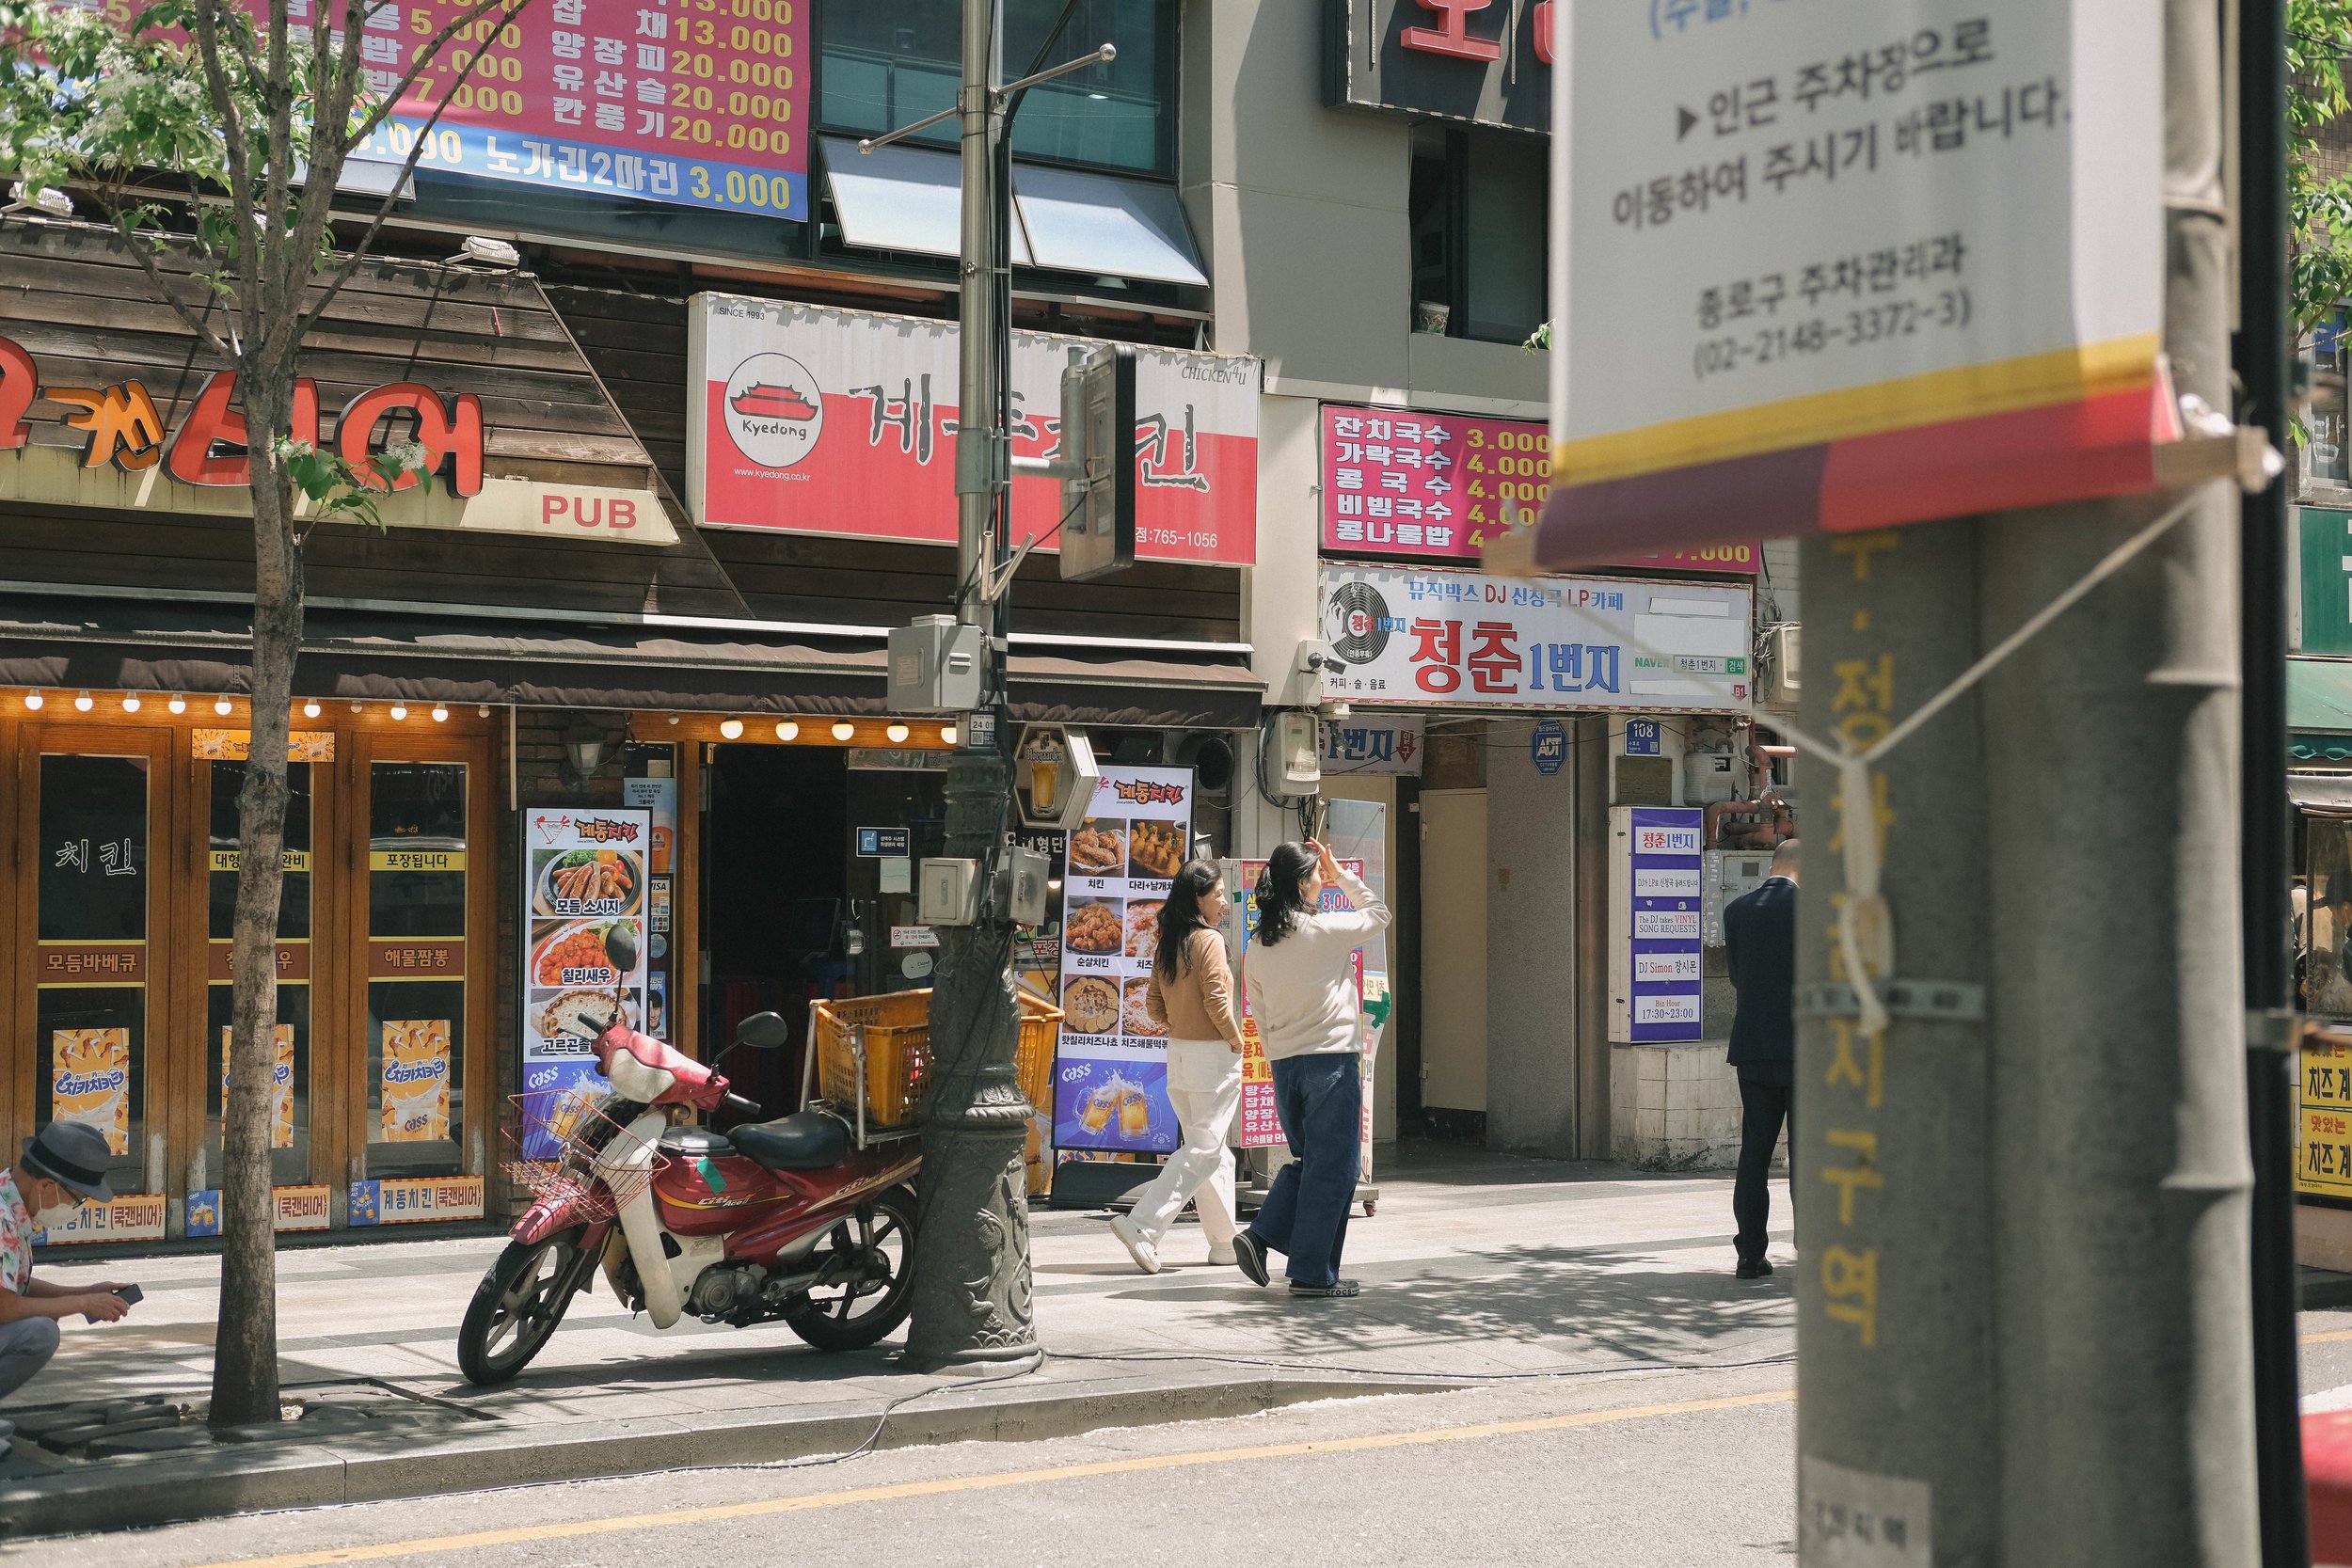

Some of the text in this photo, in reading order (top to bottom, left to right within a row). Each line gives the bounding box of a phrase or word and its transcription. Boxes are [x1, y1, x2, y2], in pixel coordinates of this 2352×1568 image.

[674, 16, 792, 57] 13.000
[671, 50, 793, 90] 20.000
[1708, 17, 1995, 138] 인근 주차장으로
[671, 83, 791, 122] 20.000
[670, 116, 790, 155] 20.000
[1612, 156, 1748, 230] 이동하여
[1762, 121, 1878, 193] 주시기
[690, 166, 790, 211] 3.000
[1695, 232, 1967, 331] 종로구 주차관리과
[719, 307, 765, 321] SINCE 1993
[1692, 287, 1973, 381] (02-2148-3372-3)
[742, 419, 807, 441] Kyedong
[1334, 415, 1551, 453] 잔치국수 3.000
[1335, 442, 1552, 479] 가락국수 4.000
[734, 468, 810, 483] www.kyedong.co.kr
[1335, 467, 1552, 503] 콩국수 4.000
[542, 495, 637, 529] PUB
[1337, 495, 1452, 522] 비빔국수
[1336, 519, 1454, 547] 콩나물밥
[1408, 580, 1480, 603] 뮤직박스
[1485, 584, 1506, 605] DJ
[1511, 587, 1562, 608] 신청곡
[1679, 659, 1716, 672] 청춘1번지
[1728, 660, 1744, 673] 검색
[1734, 686, 1744, 697] B1
[1633, 723, 1654, 737] 108
[1536, 736, 1562, 756] ADT
[574, 816, 640, 844] 계동치킨
[1643, 832, 1694, 849] 청춘1번지
[56, 837, 136, 877] 치킨
[386, 853, 449, 869] 포장됩니다
[1088, 879, 1104, 889] 치킨
[556, 898, 620, 914] 모듬 소시지
[1639, 925, 1697, 934] SONG REQUESTS
[1650, 914, 1659, 924] DJ
[1675, 914, 1697, 924] VINYL
[46, 952, 137, 974] 모듬바베큐
[384, 949, 450, 969] 해물짬뽕
[1076, 957, 1152, 970] 순살치킨 치즈
[1639, 959, 1697, 974] DJ Simon 장시몬
[562, 968, 611, 984] 칠리새우
[1642, 1007, 1693, 1020] 17:30~23:00
[1061, 1035, 1119, 1047] 핫칠리치즈나쵸
[529, 1065, 559, 1090] Cass
[1061, 1063, 1091, 1083] Cass
[2308, 1066, 2334, 1101] 치즈
[1244, 1109, 1279, 1120] 양장
[2308, 1140, 2334, 1176] 치즈
[383, 1187, 432, 1210] 계동치킨
